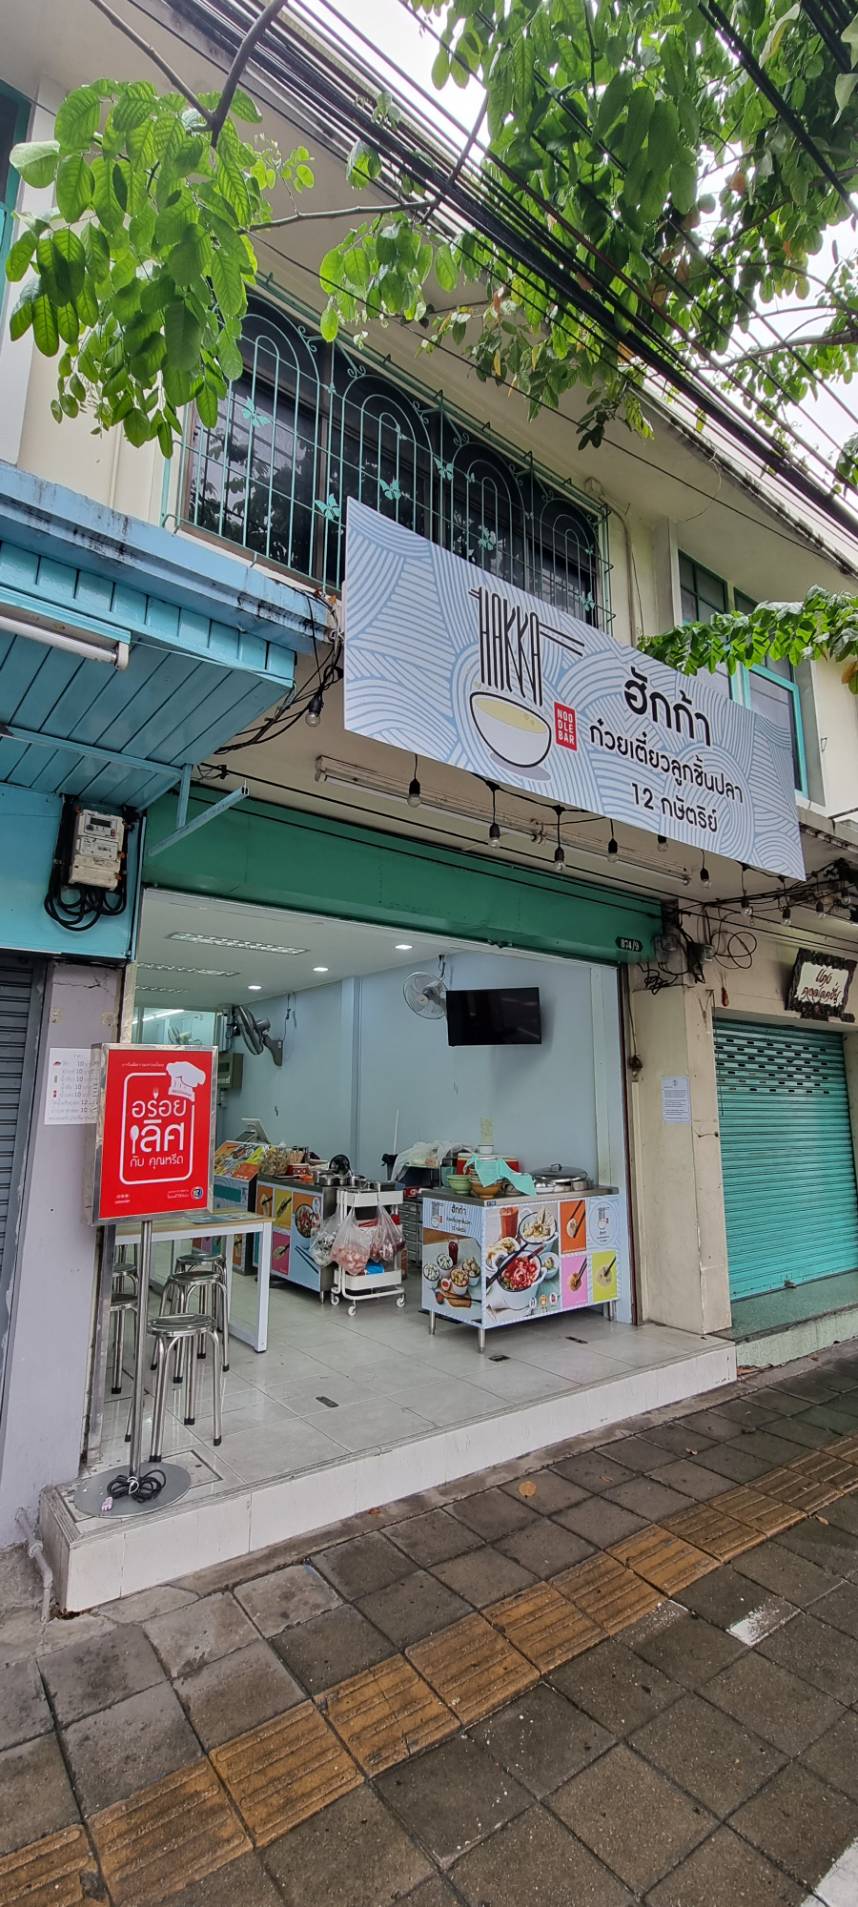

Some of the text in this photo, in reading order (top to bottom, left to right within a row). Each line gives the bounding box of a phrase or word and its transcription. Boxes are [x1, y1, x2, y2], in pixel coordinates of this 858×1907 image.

[478, 587, 543, 706] HAKKA
[624, 666, 711, 746] ฮักก้า
[558, 730, 575, 745] BAR
[589, 718, 743, 803] ก๋วยเตี๋ยวลูกชิ้นปลา
[631, 782, 718, 832] 12 กษัตริย์
[131, 1087, 187, 1118] อร่อย
[130, 1155, 145, 1168] กับ
